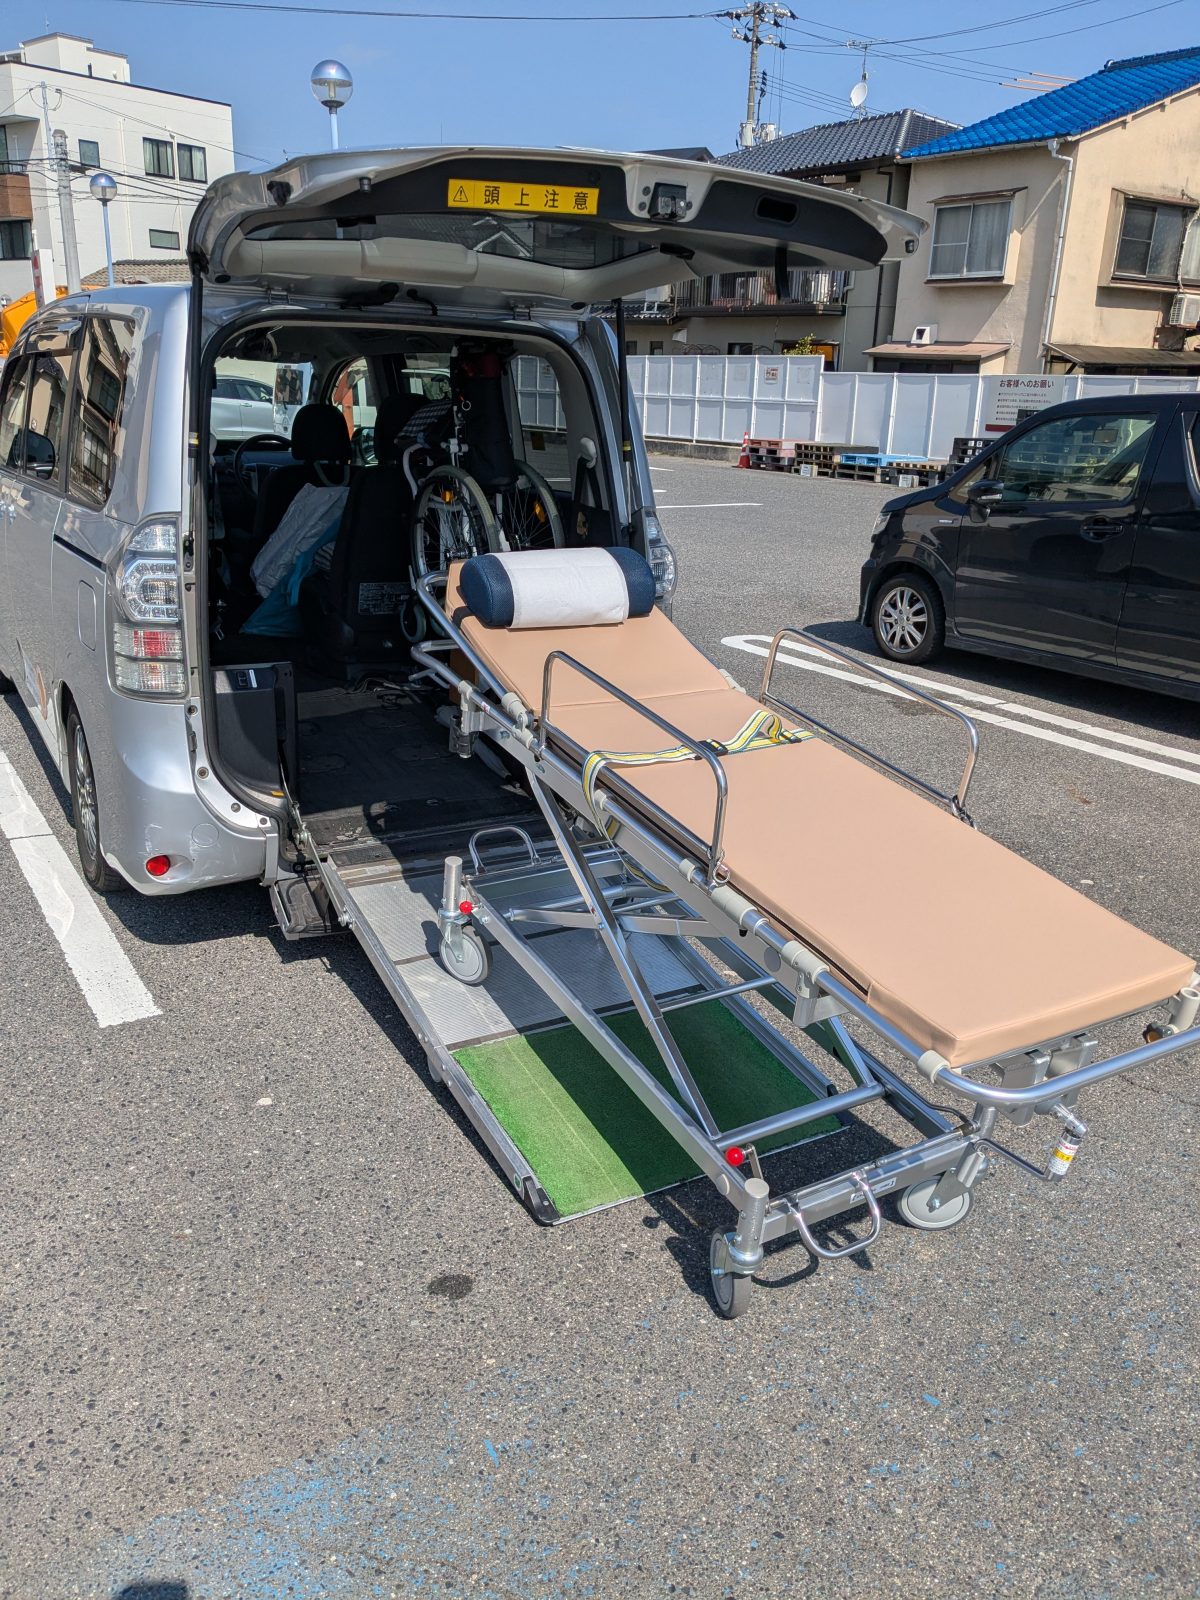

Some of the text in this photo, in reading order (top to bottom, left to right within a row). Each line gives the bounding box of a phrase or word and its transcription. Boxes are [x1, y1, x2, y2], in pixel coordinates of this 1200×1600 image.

[483, 185, 589, 211] 頭上注意
[999, 379, 1055, 389] お客様へのお願い
